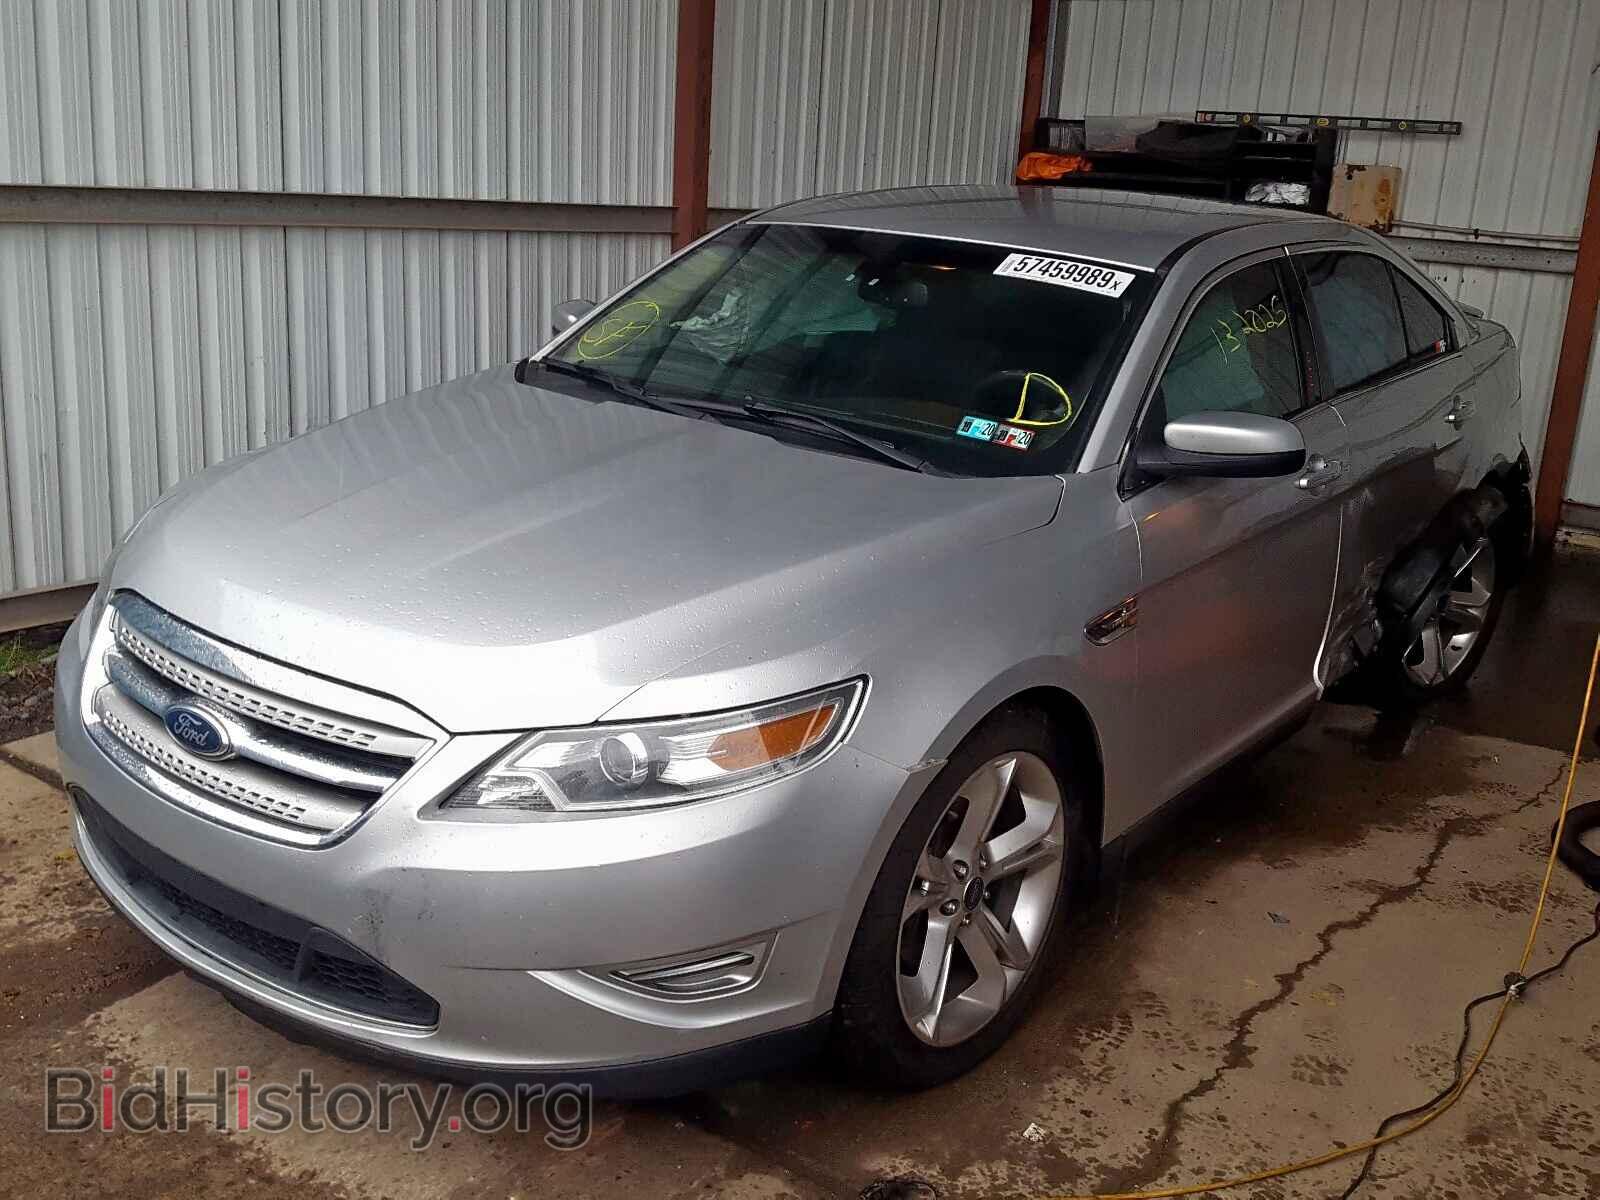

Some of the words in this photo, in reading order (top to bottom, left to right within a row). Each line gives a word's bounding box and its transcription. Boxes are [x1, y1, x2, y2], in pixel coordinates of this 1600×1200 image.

[981, 422, 996, 436] 20
[1017, 431, 1032, 445] 20
[173, 712, 210, 746] Ford
